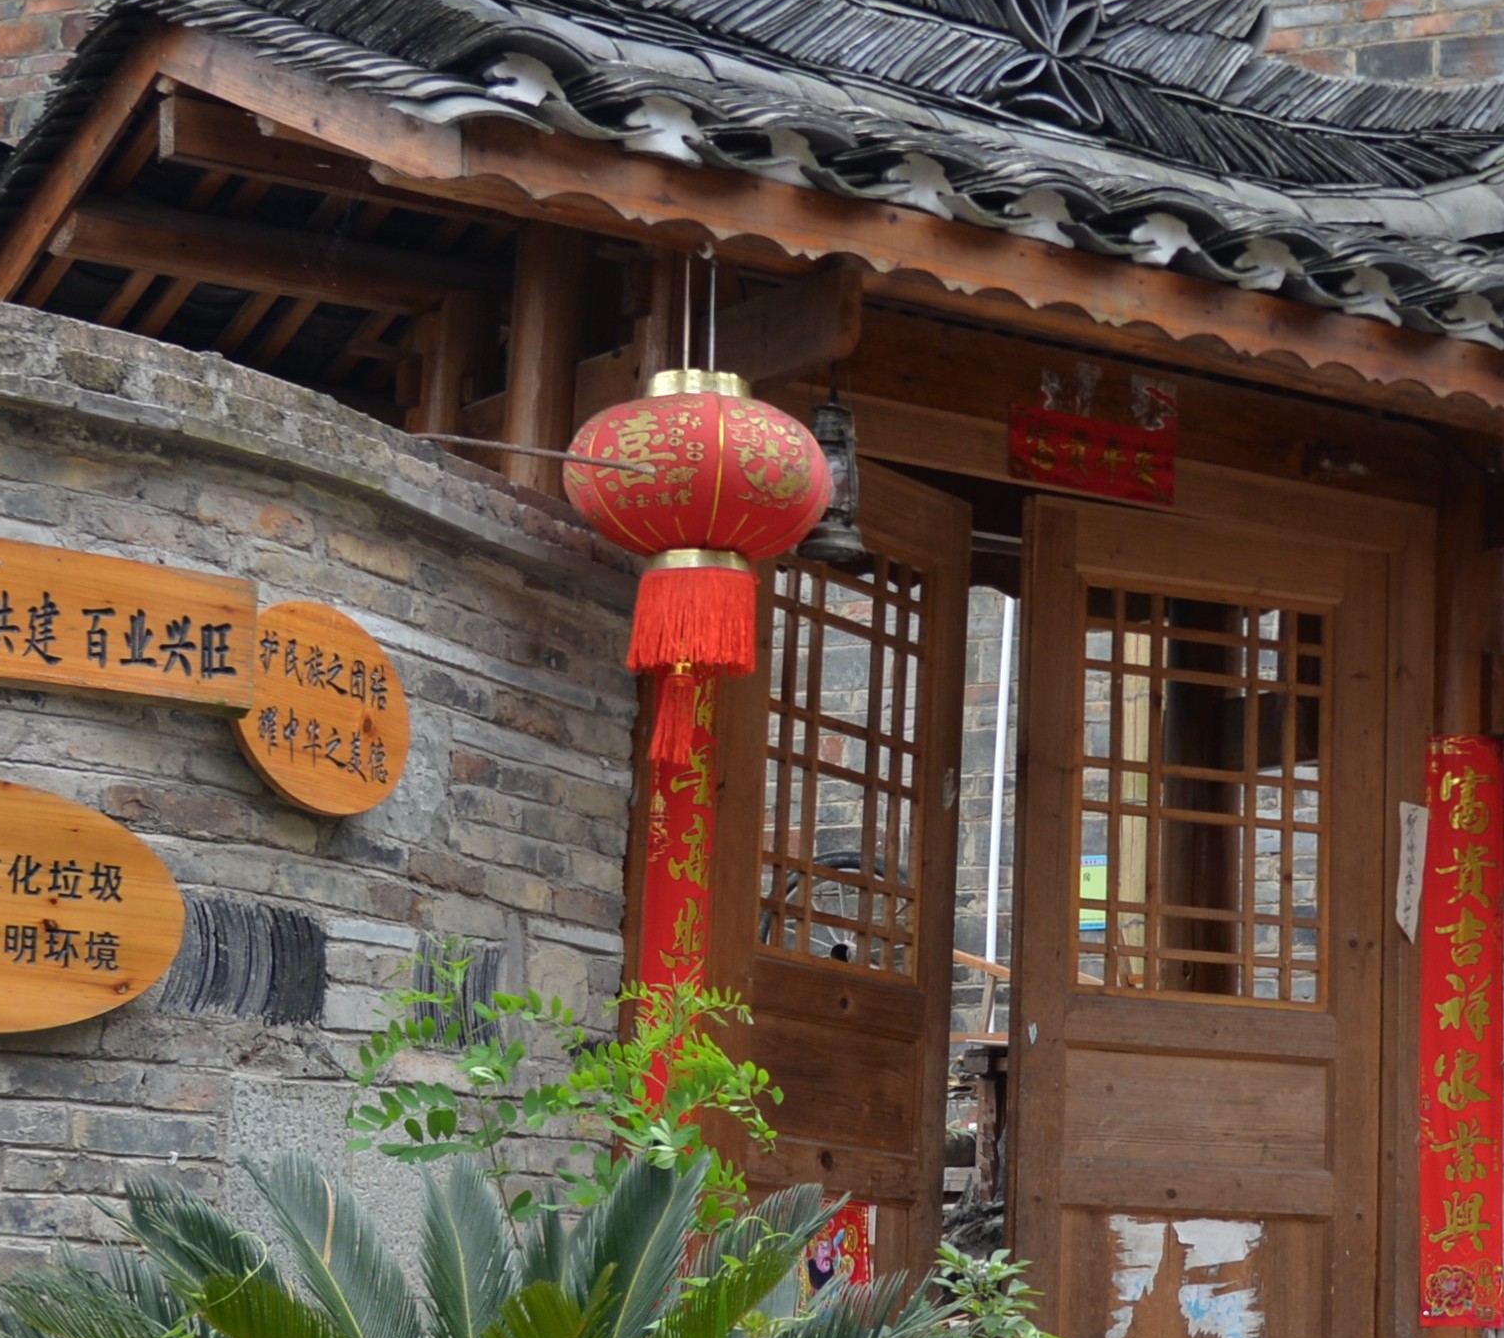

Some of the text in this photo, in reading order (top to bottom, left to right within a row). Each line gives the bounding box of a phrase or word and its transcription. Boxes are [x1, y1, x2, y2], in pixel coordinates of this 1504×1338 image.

[597, 411, 678, 489] 喜
[82, 608, 238, 680] 百业兴旺
[259, 629, 389, 711] 护民族之团结
[257, 705, 390, 785] 耀中华之美德
